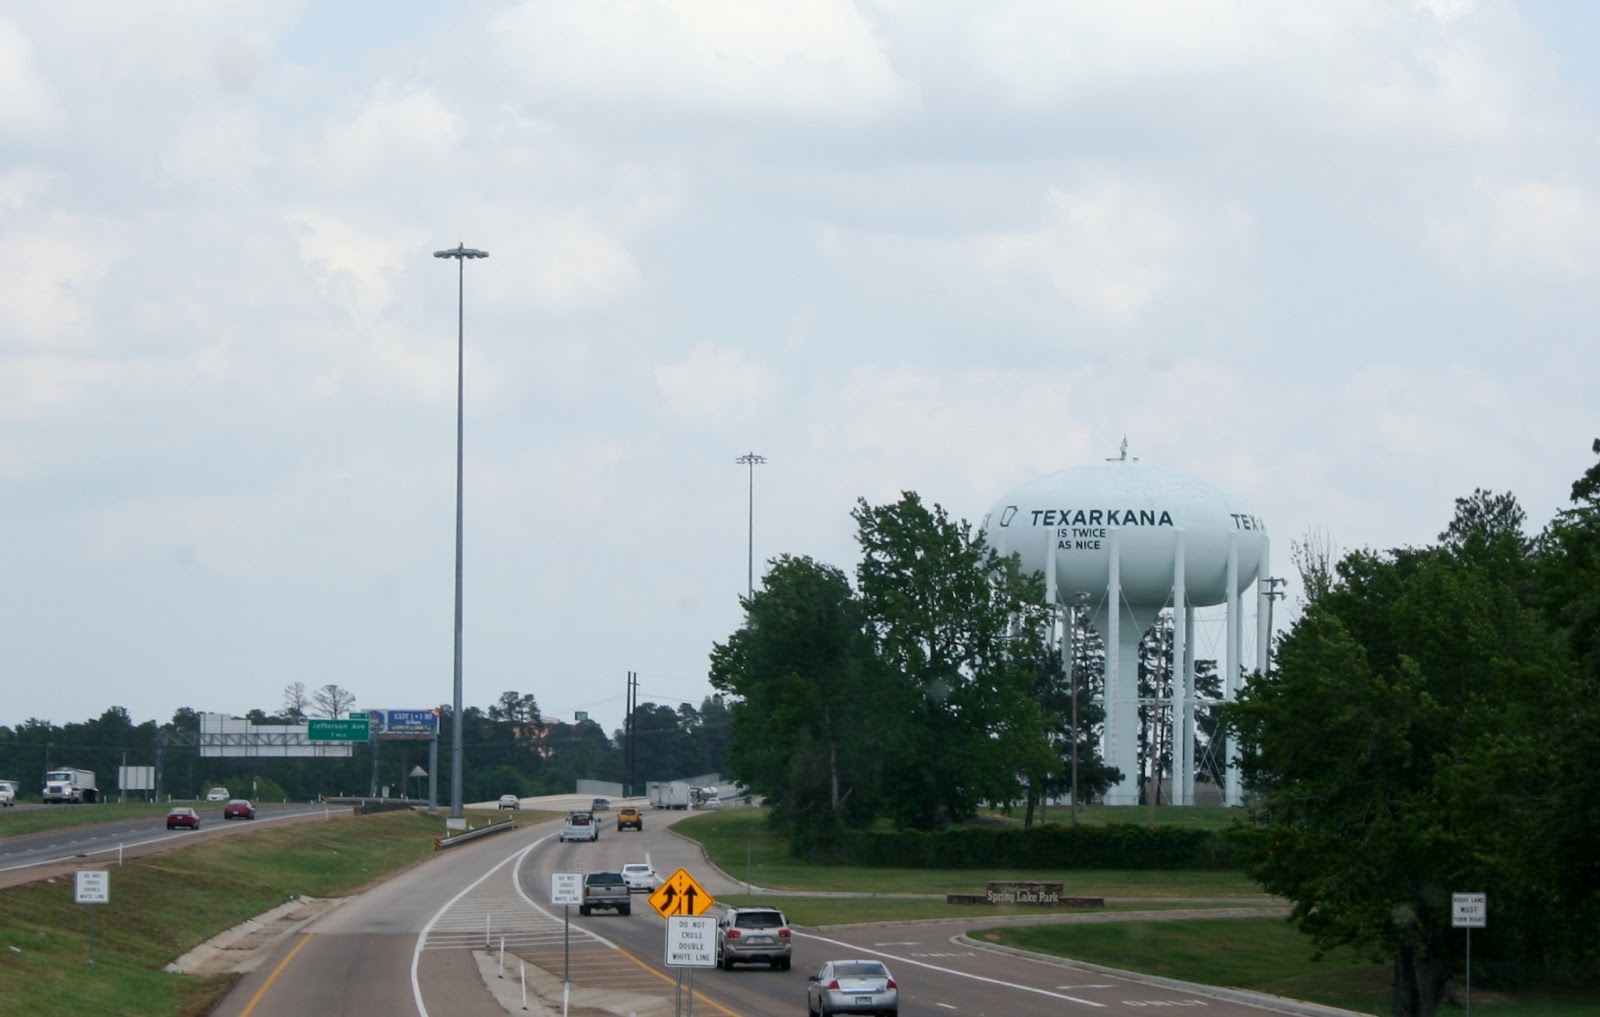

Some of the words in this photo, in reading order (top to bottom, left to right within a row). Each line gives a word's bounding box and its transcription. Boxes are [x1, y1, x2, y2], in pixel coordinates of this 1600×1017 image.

[1031, 509, 1174, 526] TEXARKANA
[1057, 528, 1067, 538] IS
[1072, 528, 1106, 538] TWICE
[1058, 540, 1072, 550] AS
[1075, 540, 1101, 550] NICE
[987, 890, 1015, 904] Spring
[1017, 890, 1037, 903] Lake
[1039, 891, 1059, 903] Park
